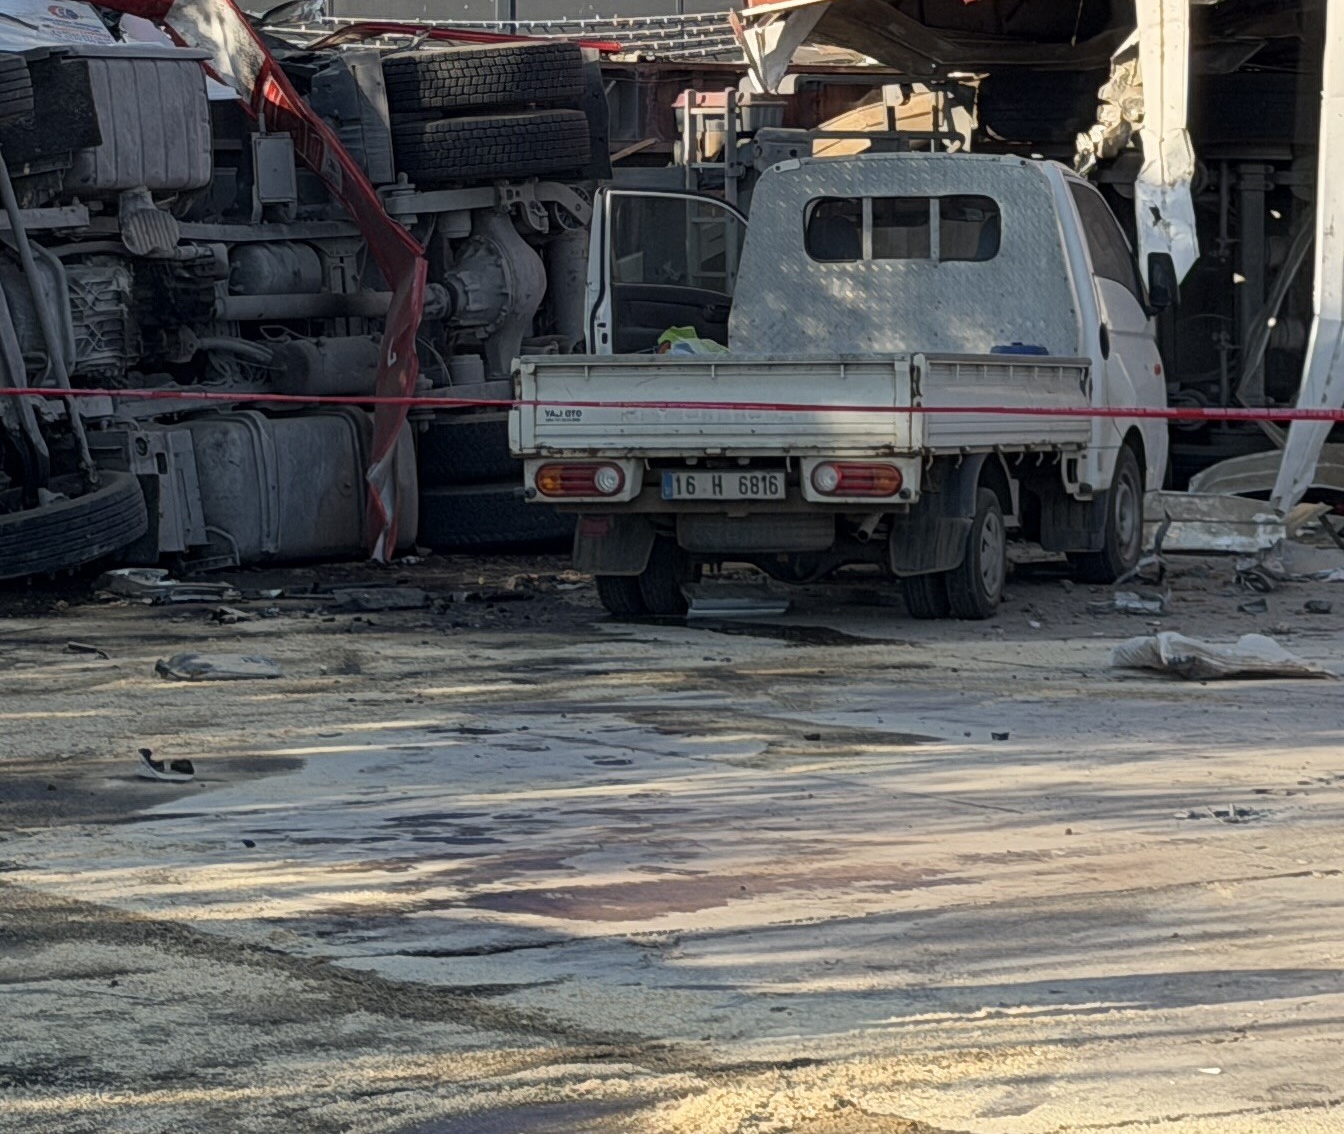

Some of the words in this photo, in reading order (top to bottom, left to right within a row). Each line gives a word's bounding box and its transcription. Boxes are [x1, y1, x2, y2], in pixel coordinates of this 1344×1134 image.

[675, 474, 696, 496] 16
[712, 474, 723, 496] H
[738, 474, 778, 496] 6816
